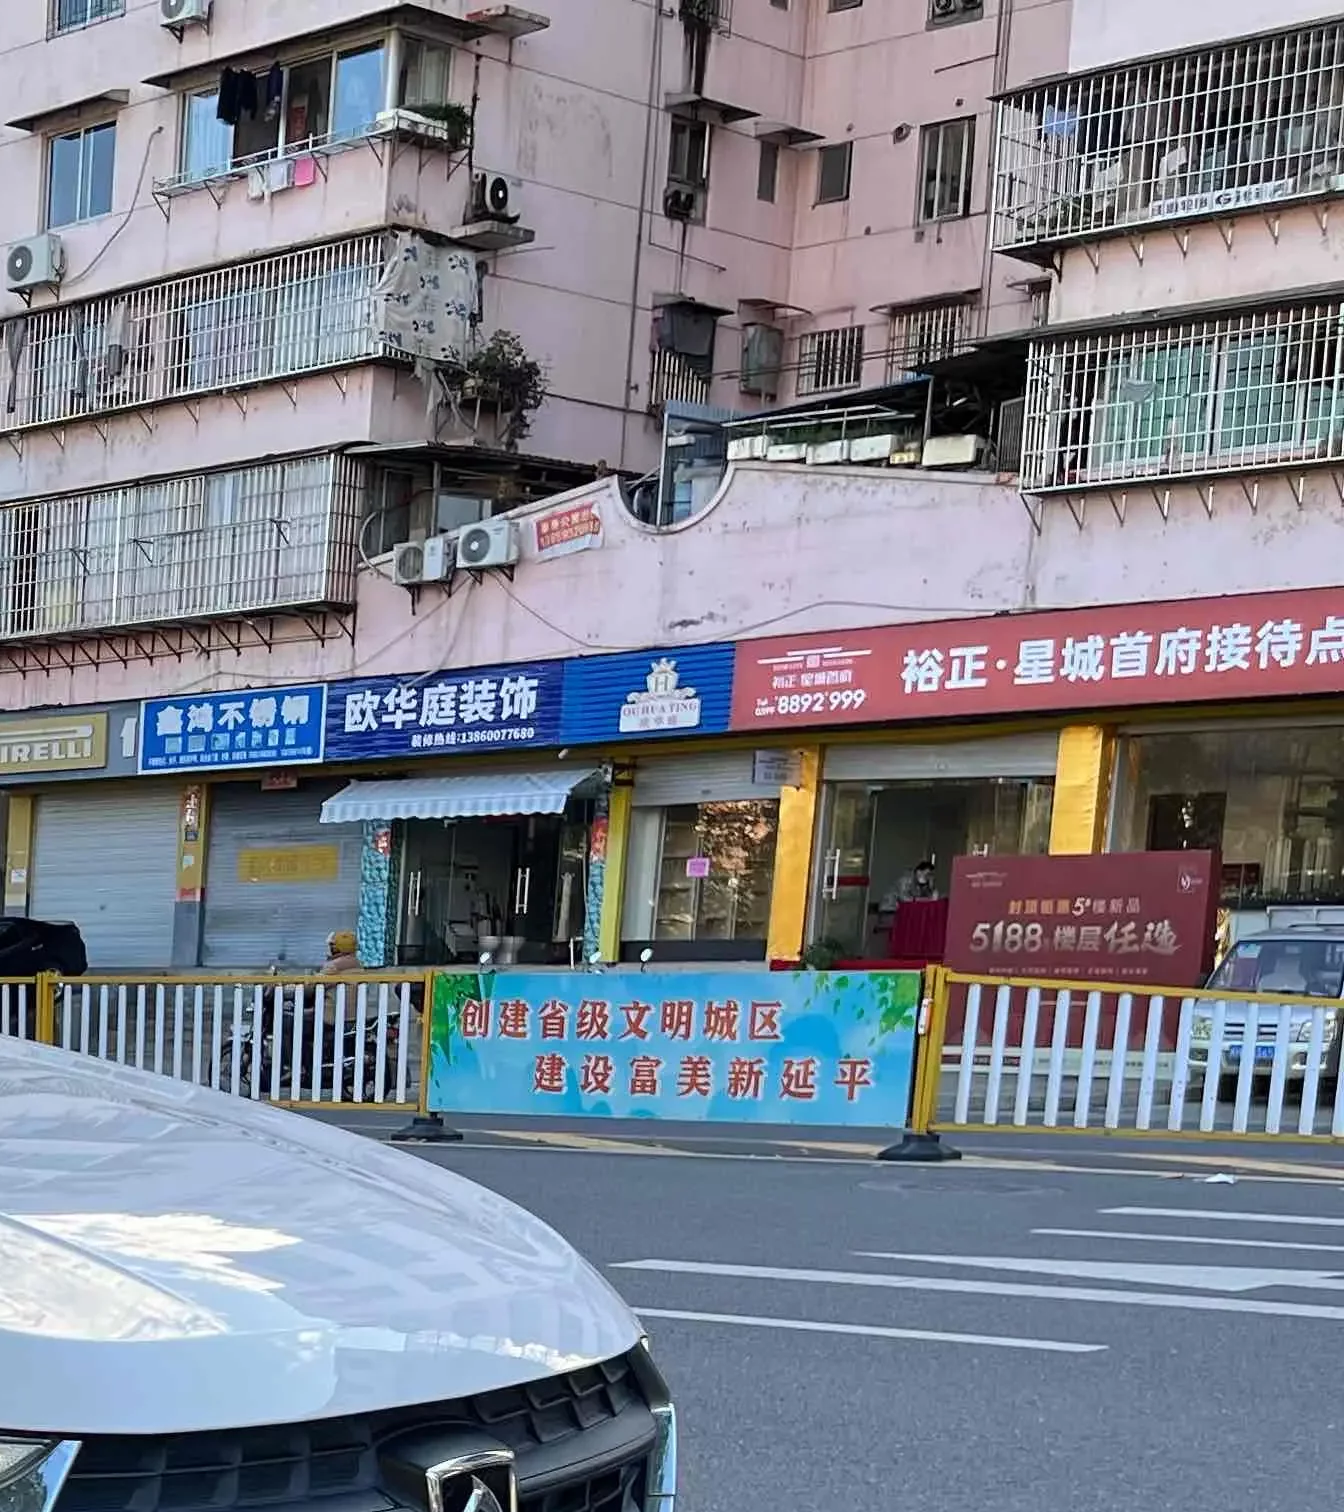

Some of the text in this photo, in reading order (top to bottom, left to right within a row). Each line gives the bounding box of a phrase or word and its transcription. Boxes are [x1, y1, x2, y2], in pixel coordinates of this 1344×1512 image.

[900, 615, 1344, 694] 裕正·星城首府接待点
[344, 676, 539, 732] 欧华庭装饰
[460, 1000, 784, 1041] 创建省级文明城区
[533, 1054, 874, 1101] 建设富美新延平
